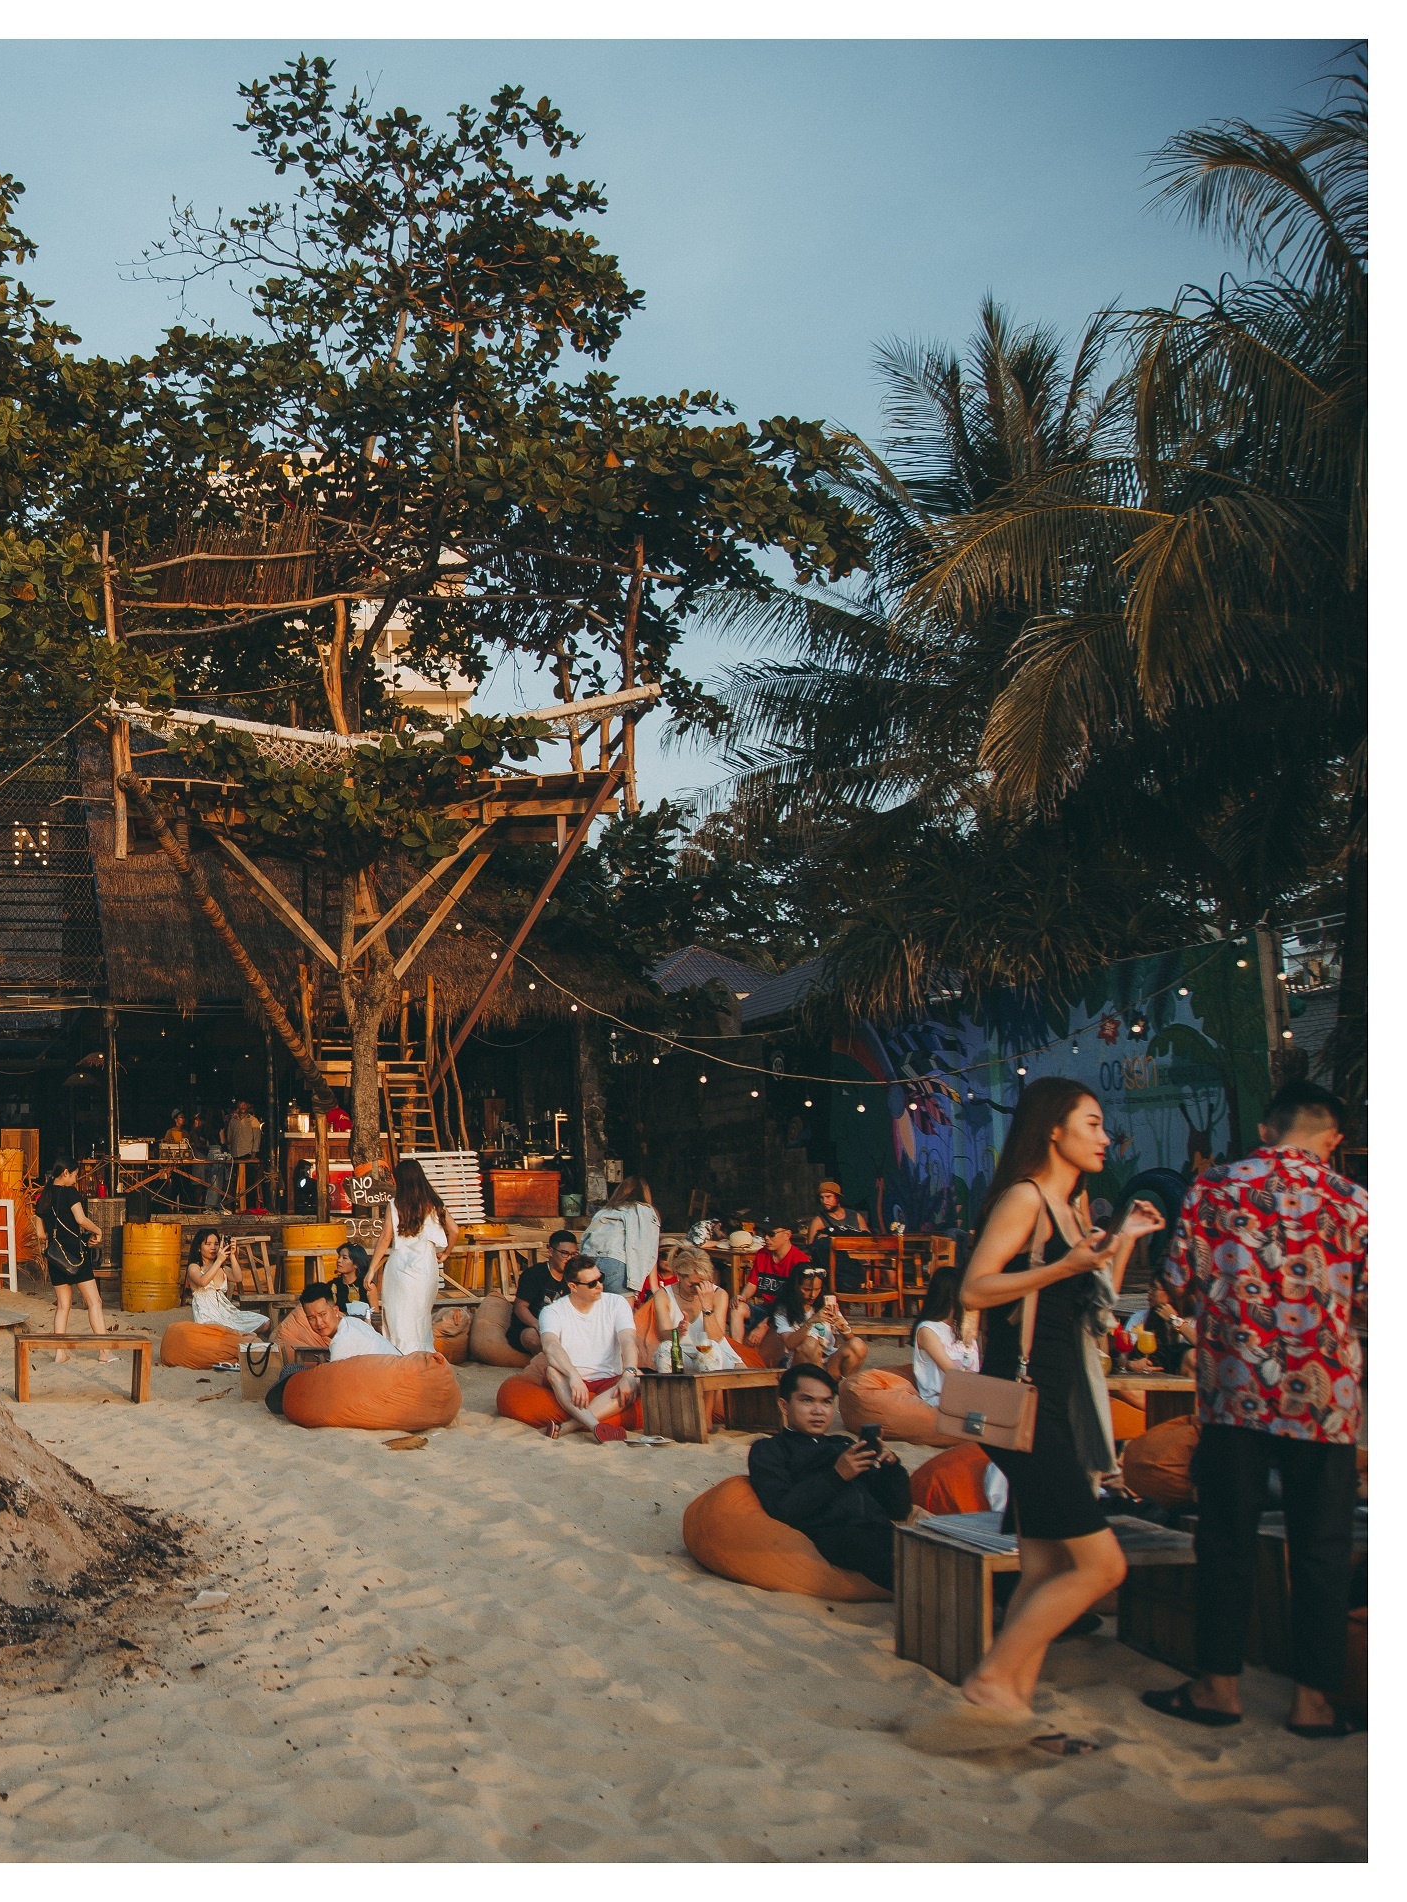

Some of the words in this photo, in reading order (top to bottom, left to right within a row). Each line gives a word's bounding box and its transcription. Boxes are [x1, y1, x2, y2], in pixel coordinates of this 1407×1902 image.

[352, 1176, 373, 1190] NO
[354, 1190, 392, 1205] Plastic
[344, 1218, 384, 1238] OCS
